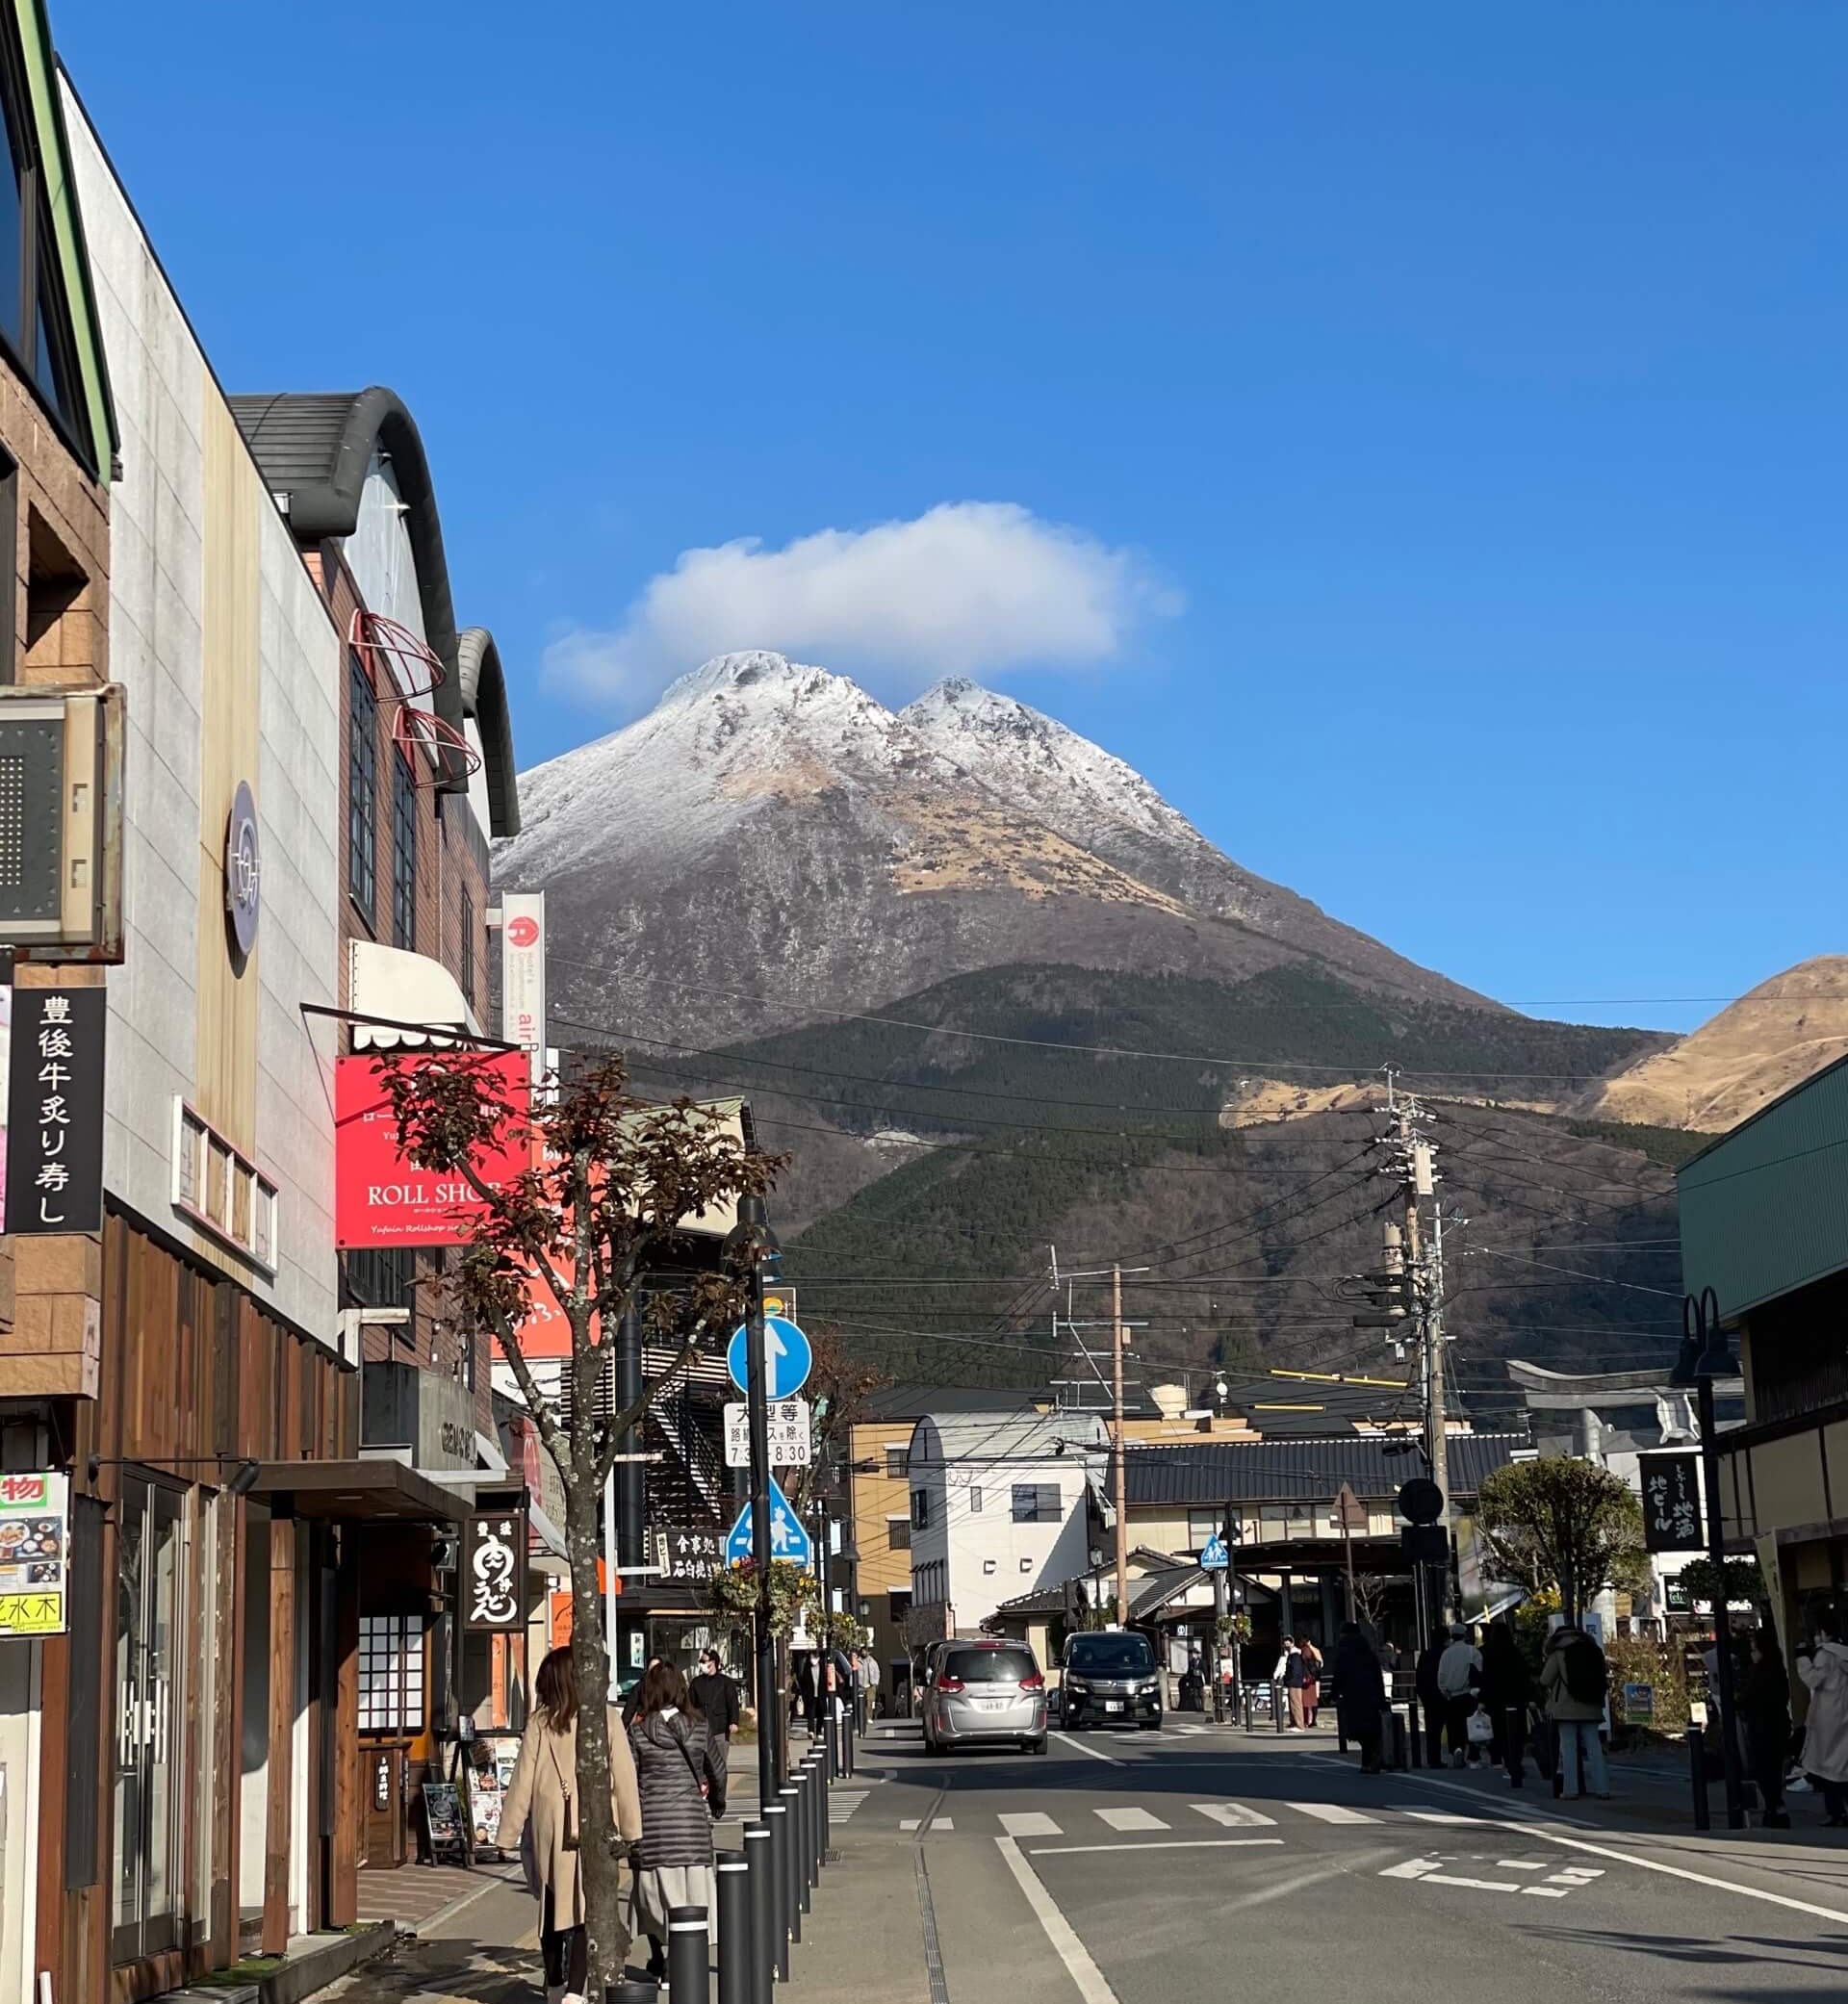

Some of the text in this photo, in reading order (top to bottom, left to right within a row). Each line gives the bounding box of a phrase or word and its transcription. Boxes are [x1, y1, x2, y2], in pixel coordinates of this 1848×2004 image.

[35, 995, 74, 1223] 豊後牛炙り寿し
[368, 1184, 429, 1206] ROLL
